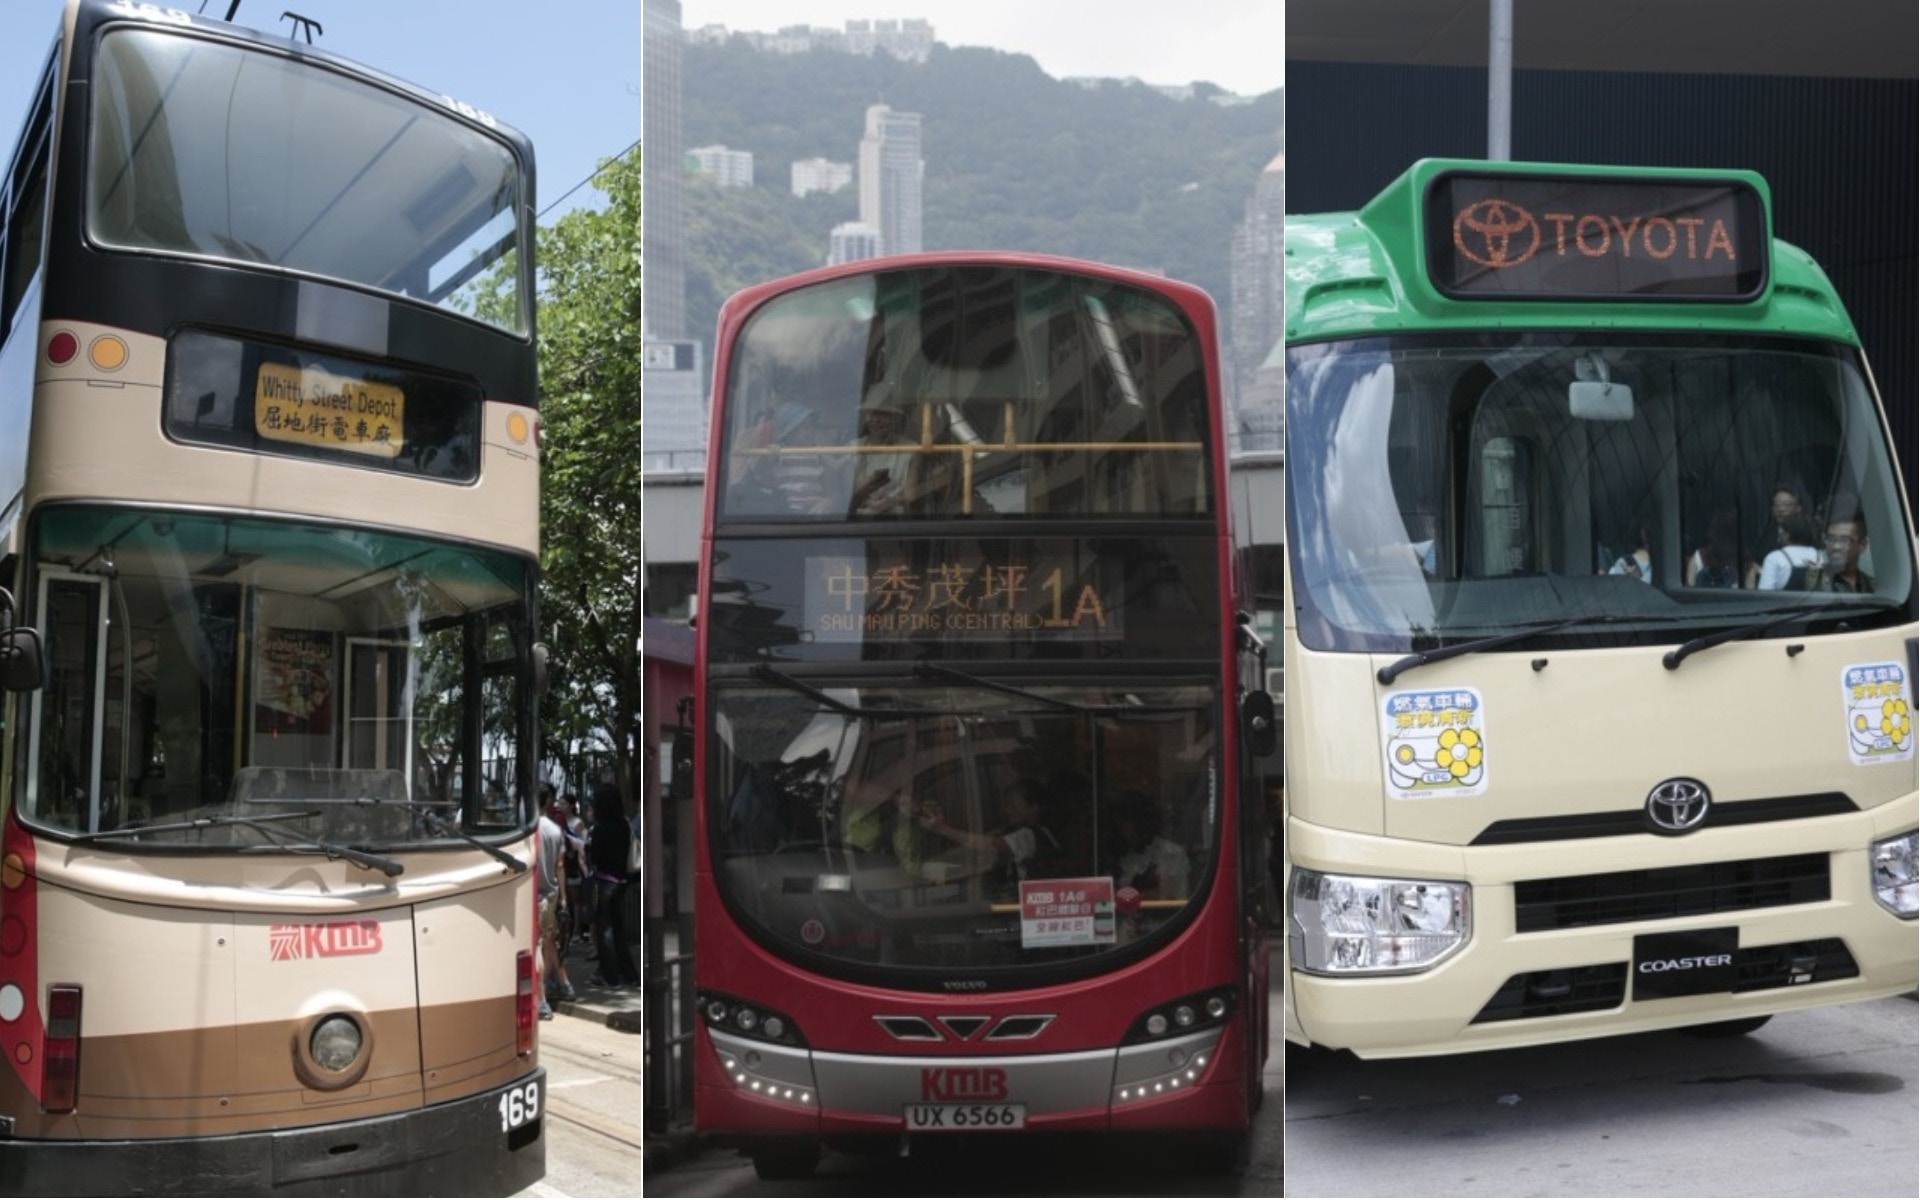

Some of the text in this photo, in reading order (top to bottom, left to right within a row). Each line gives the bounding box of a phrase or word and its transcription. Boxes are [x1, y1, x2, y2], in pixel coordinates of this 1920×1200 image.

[1544, 213, 1737, 260] TOYOTA
[262, 375, 397, 419] Whitty Street Depot
[1042, 567, 1107, 628] 1A
[820, 614, 854, 632] SAU
[898, 614, 941, 630] PING
[1639, 954, 1732, 973] COASTER
[921, 1066, 1008, 1102] KMB
[498, 1081, 538, 1133] 169
[914, 1106, 1015, 1126] UX 6566
